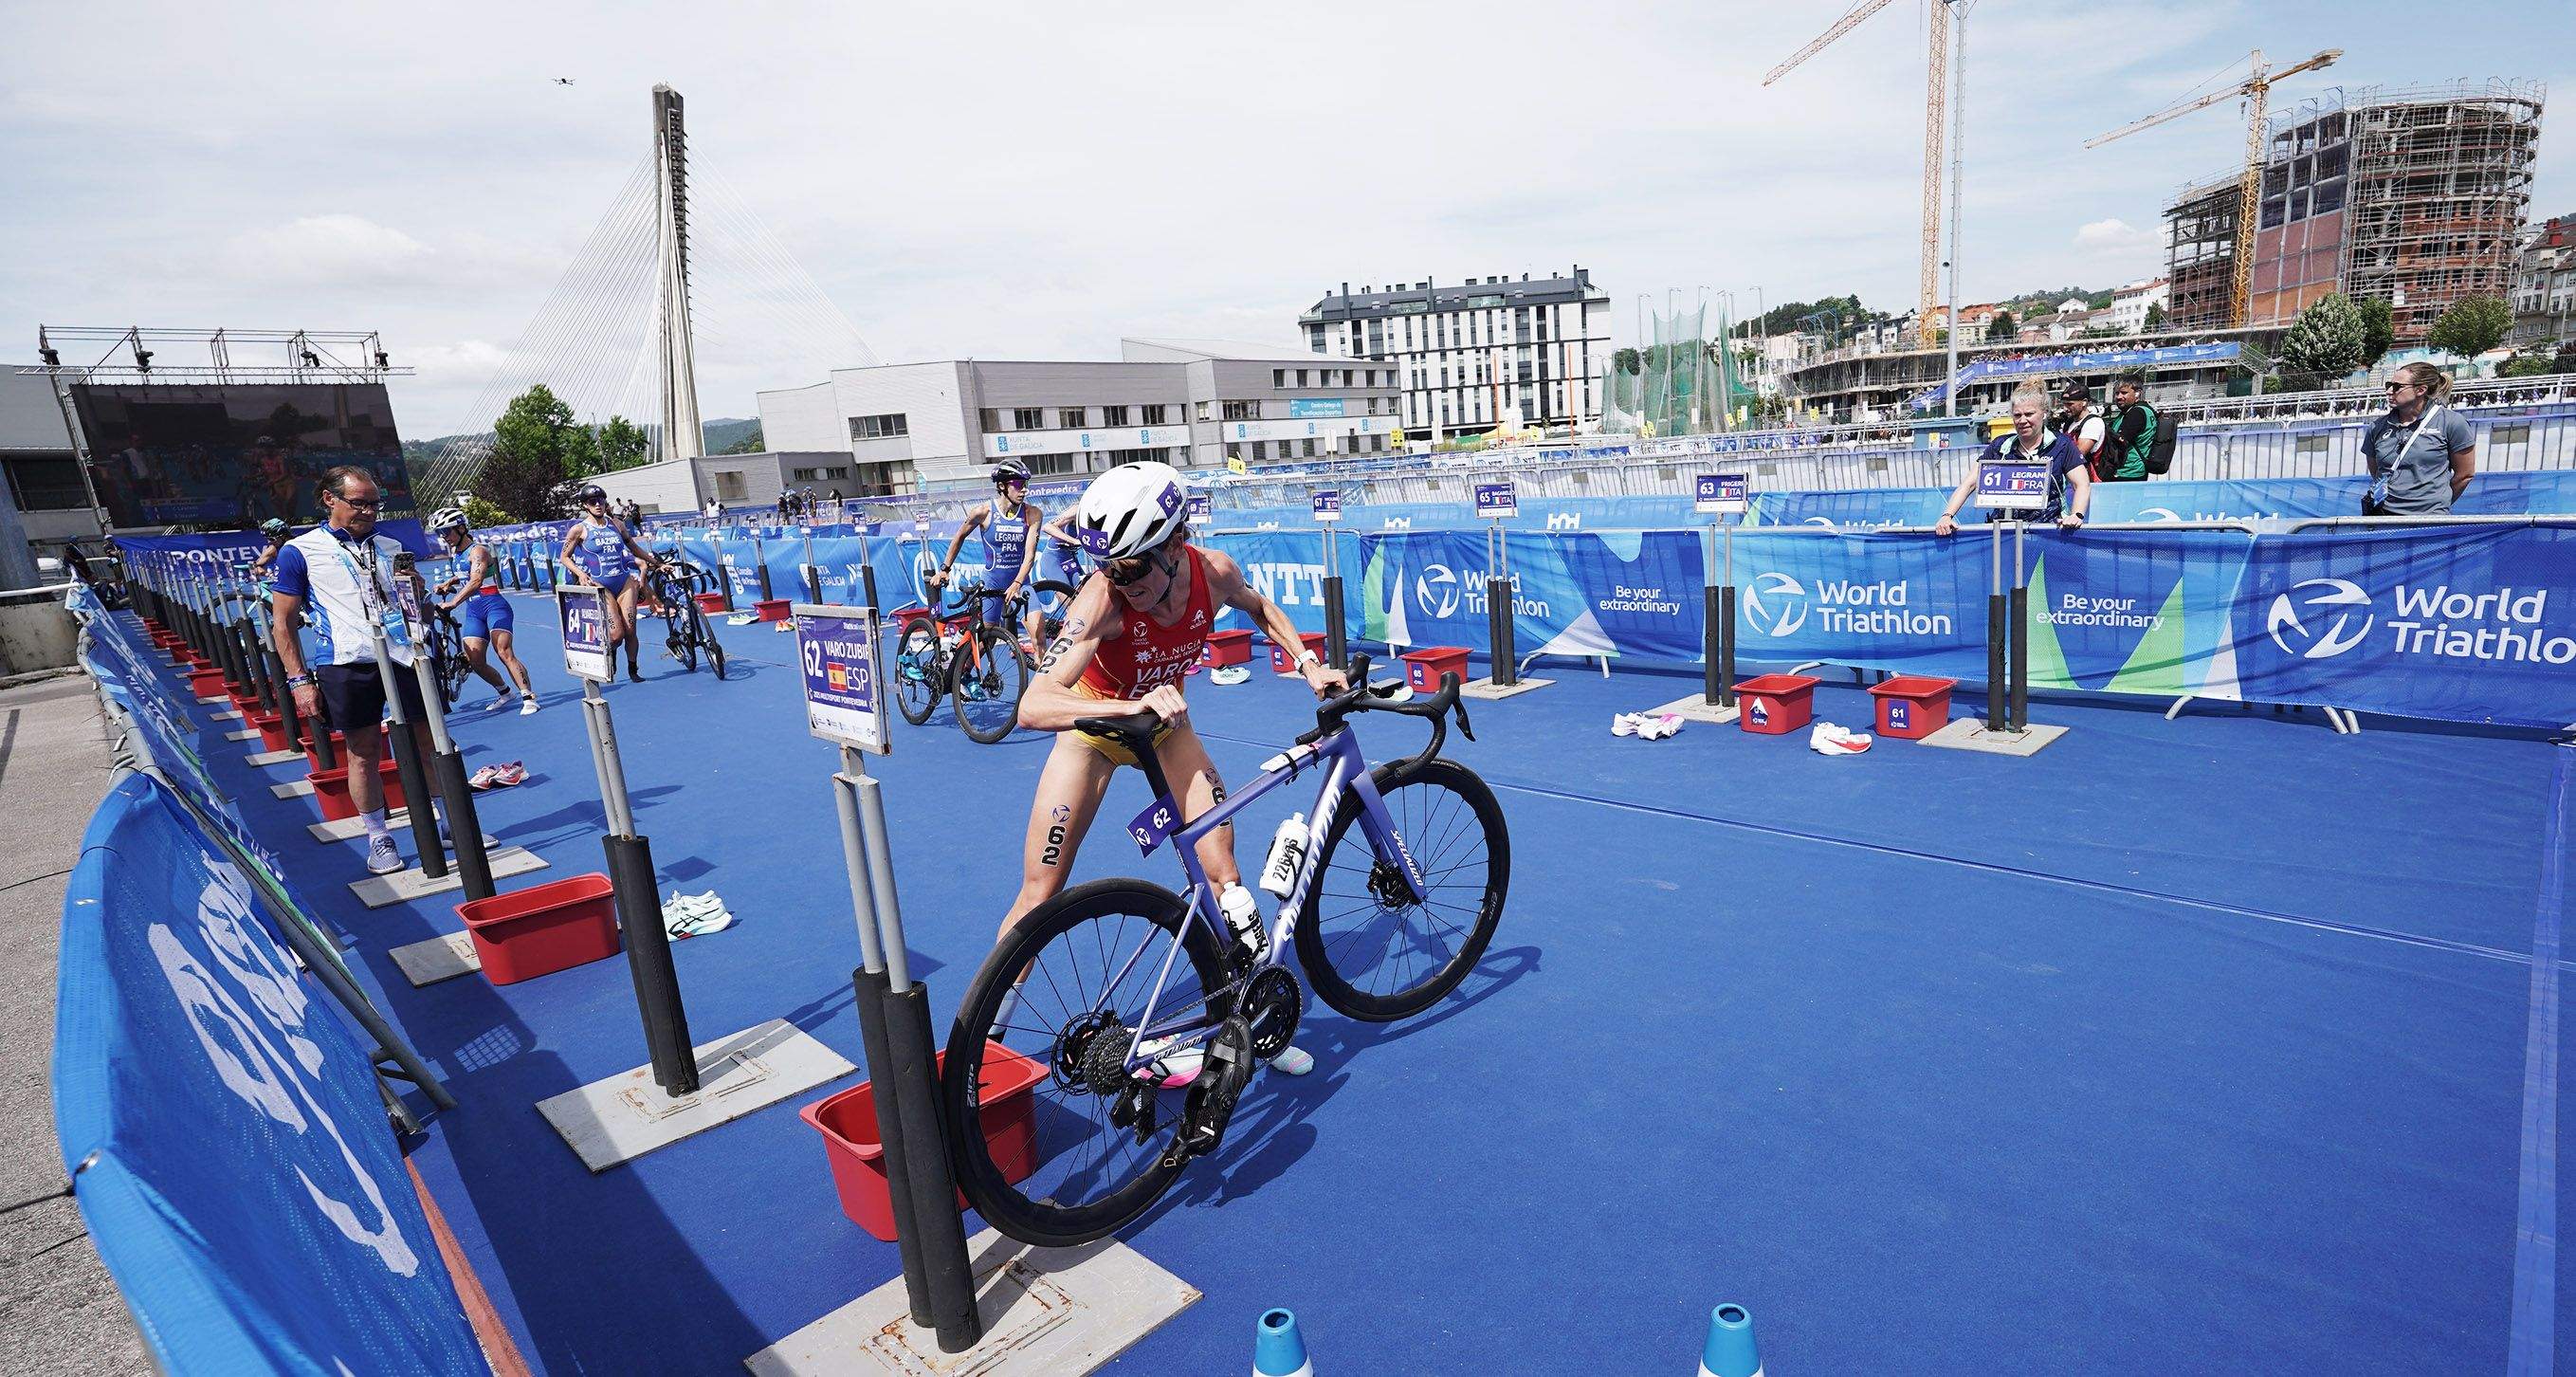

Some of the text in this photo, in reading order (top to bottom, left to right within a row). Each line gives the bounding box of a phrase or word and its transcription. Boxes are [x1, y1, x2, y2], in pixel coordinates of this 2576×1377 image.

[1700, 482, 1714, 495] 63
[1983, 472, 2001, 487] 61
[2023, 480, 2044, 489] FRA
[1164, 494, 1175, 508] 62
[1314, 497, 1323, 506] 67
[1479, 491, 1490, 503] 65
[594, 536, 621, 546] BAZIRE
[603, 544, 616, 553] FRA
[995, 532, 1024, 542] LEGRAND
[1001, 542, 1018, 552] FRA
[1082, 534, 1090, 546] 62
[1247, 562, 1325, 606] NTT
[1463, 569, 1521, 592] Wod
[1816, 578, 1908, 606] World
[1615, 585, 1661, 601] Be your
[2063, 593, 2136, 616] Be your
[2395, 584, 2548, 624] World
[1464, 592, 1550, 618] Trihlon
[1599, 597, 1681, 615] extraordinary
[568, 608, 580, 633] 64
[1816, 607, 1951, 635] Triathlon
[2036, 609, 2165, 633] extraordinary
[804, 639, 824, 678] 62
[825, 640, 846, 658] VARO
[1036, 636, 1074, 674] 62
[846, 666, 869, 691] ESP
[1137, 657, 1194, 684] VARO
[1413, 669, 1422, 678] 65
[1891, 707, 1904, 719] 61
[1153, 807, 1172, 830] 62
[1041, 825, 1067, 867] 62
[1390, 829, 1424, 887] SPECIALIZED
